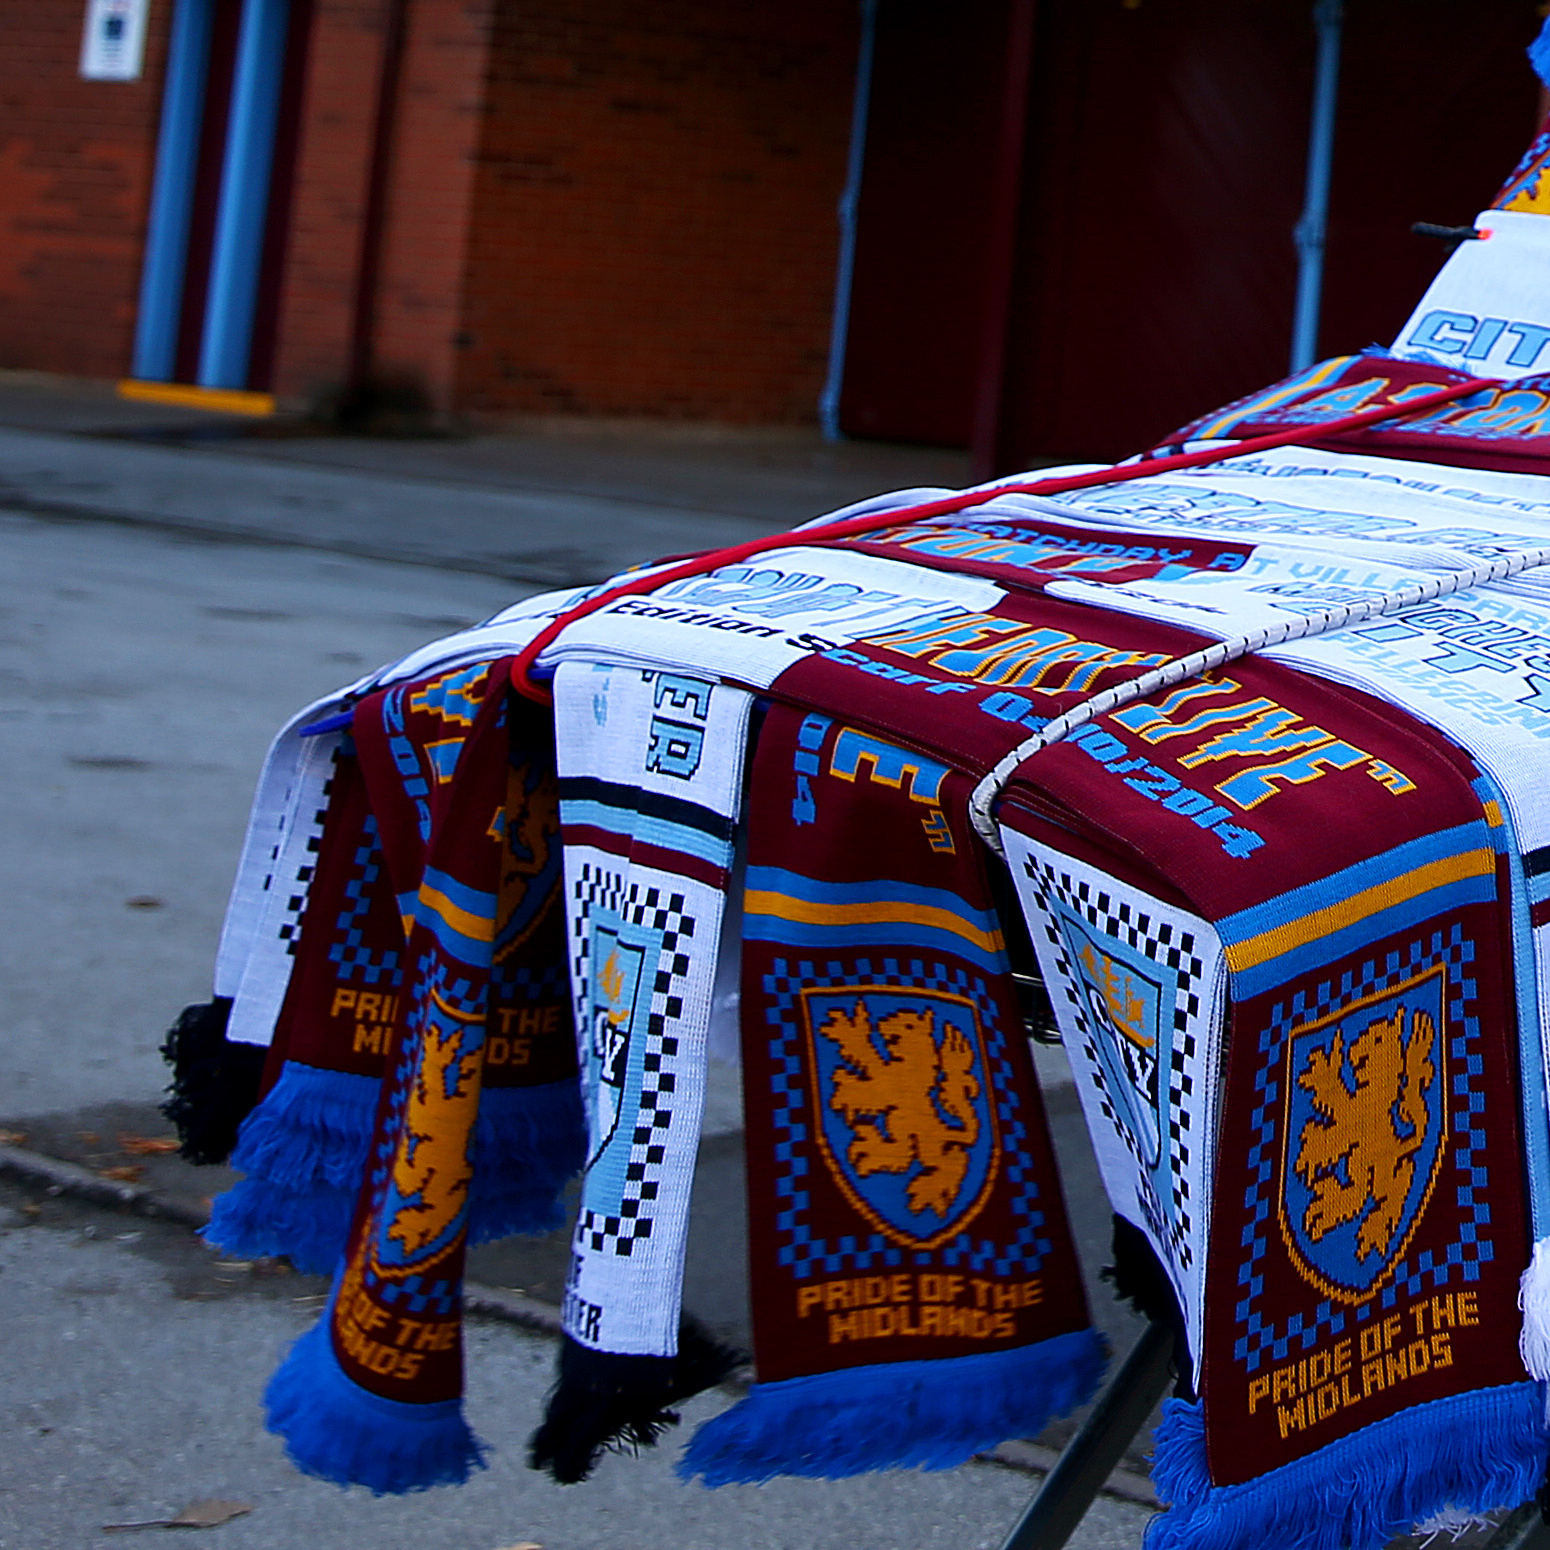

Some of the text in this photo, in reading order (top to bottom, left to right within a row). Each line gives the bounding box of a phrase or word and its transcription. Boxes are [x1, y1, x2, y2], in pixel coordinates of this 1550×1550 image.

[605, 599, 787, 638] Edition
[786, 633, 977, 696] Scarf
[796, 1272, 1045, 1320] PRIDE OF THE
[827, 1301, 1018, 1345] MIDLANDS
[1247, 1291, 1481, 1415] PRIDE OF THE
[1277, 1333, 1455, 1440] MIDLANDS
